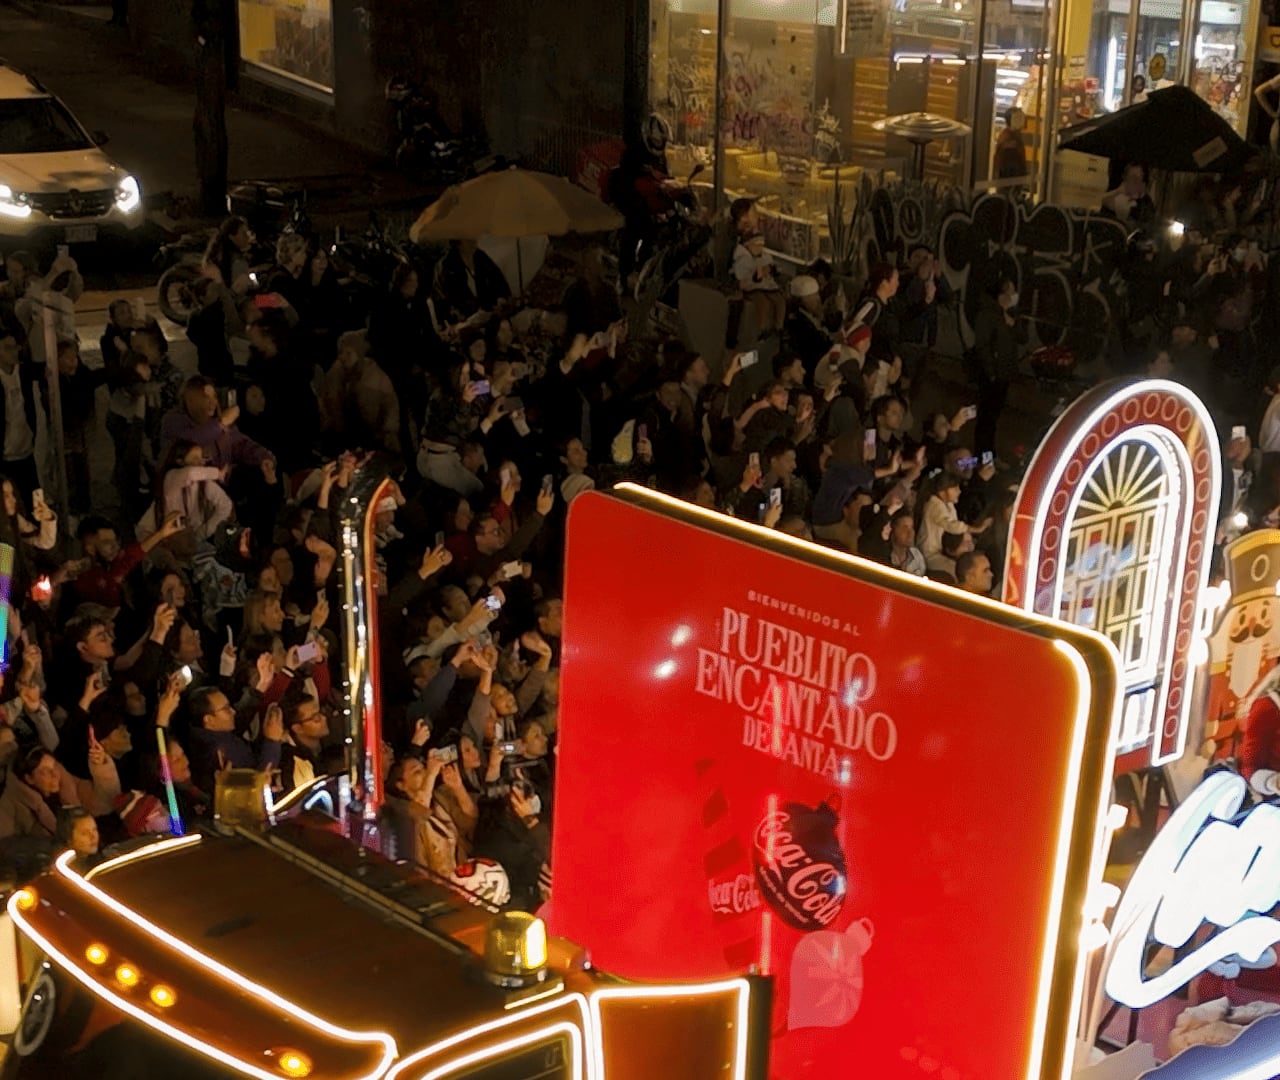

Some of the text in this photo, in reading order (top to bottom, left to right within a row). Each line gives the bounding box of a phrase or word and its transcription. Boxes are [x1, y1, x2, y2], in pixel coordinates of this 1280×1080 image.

[747, 589, 862, 637] BIENVENIDOS AL
[720, 606, 877, 702] PUEBLITO
[695, 647, 898, 761] ENCANTADO
[742, 715, 771, 753] DE
